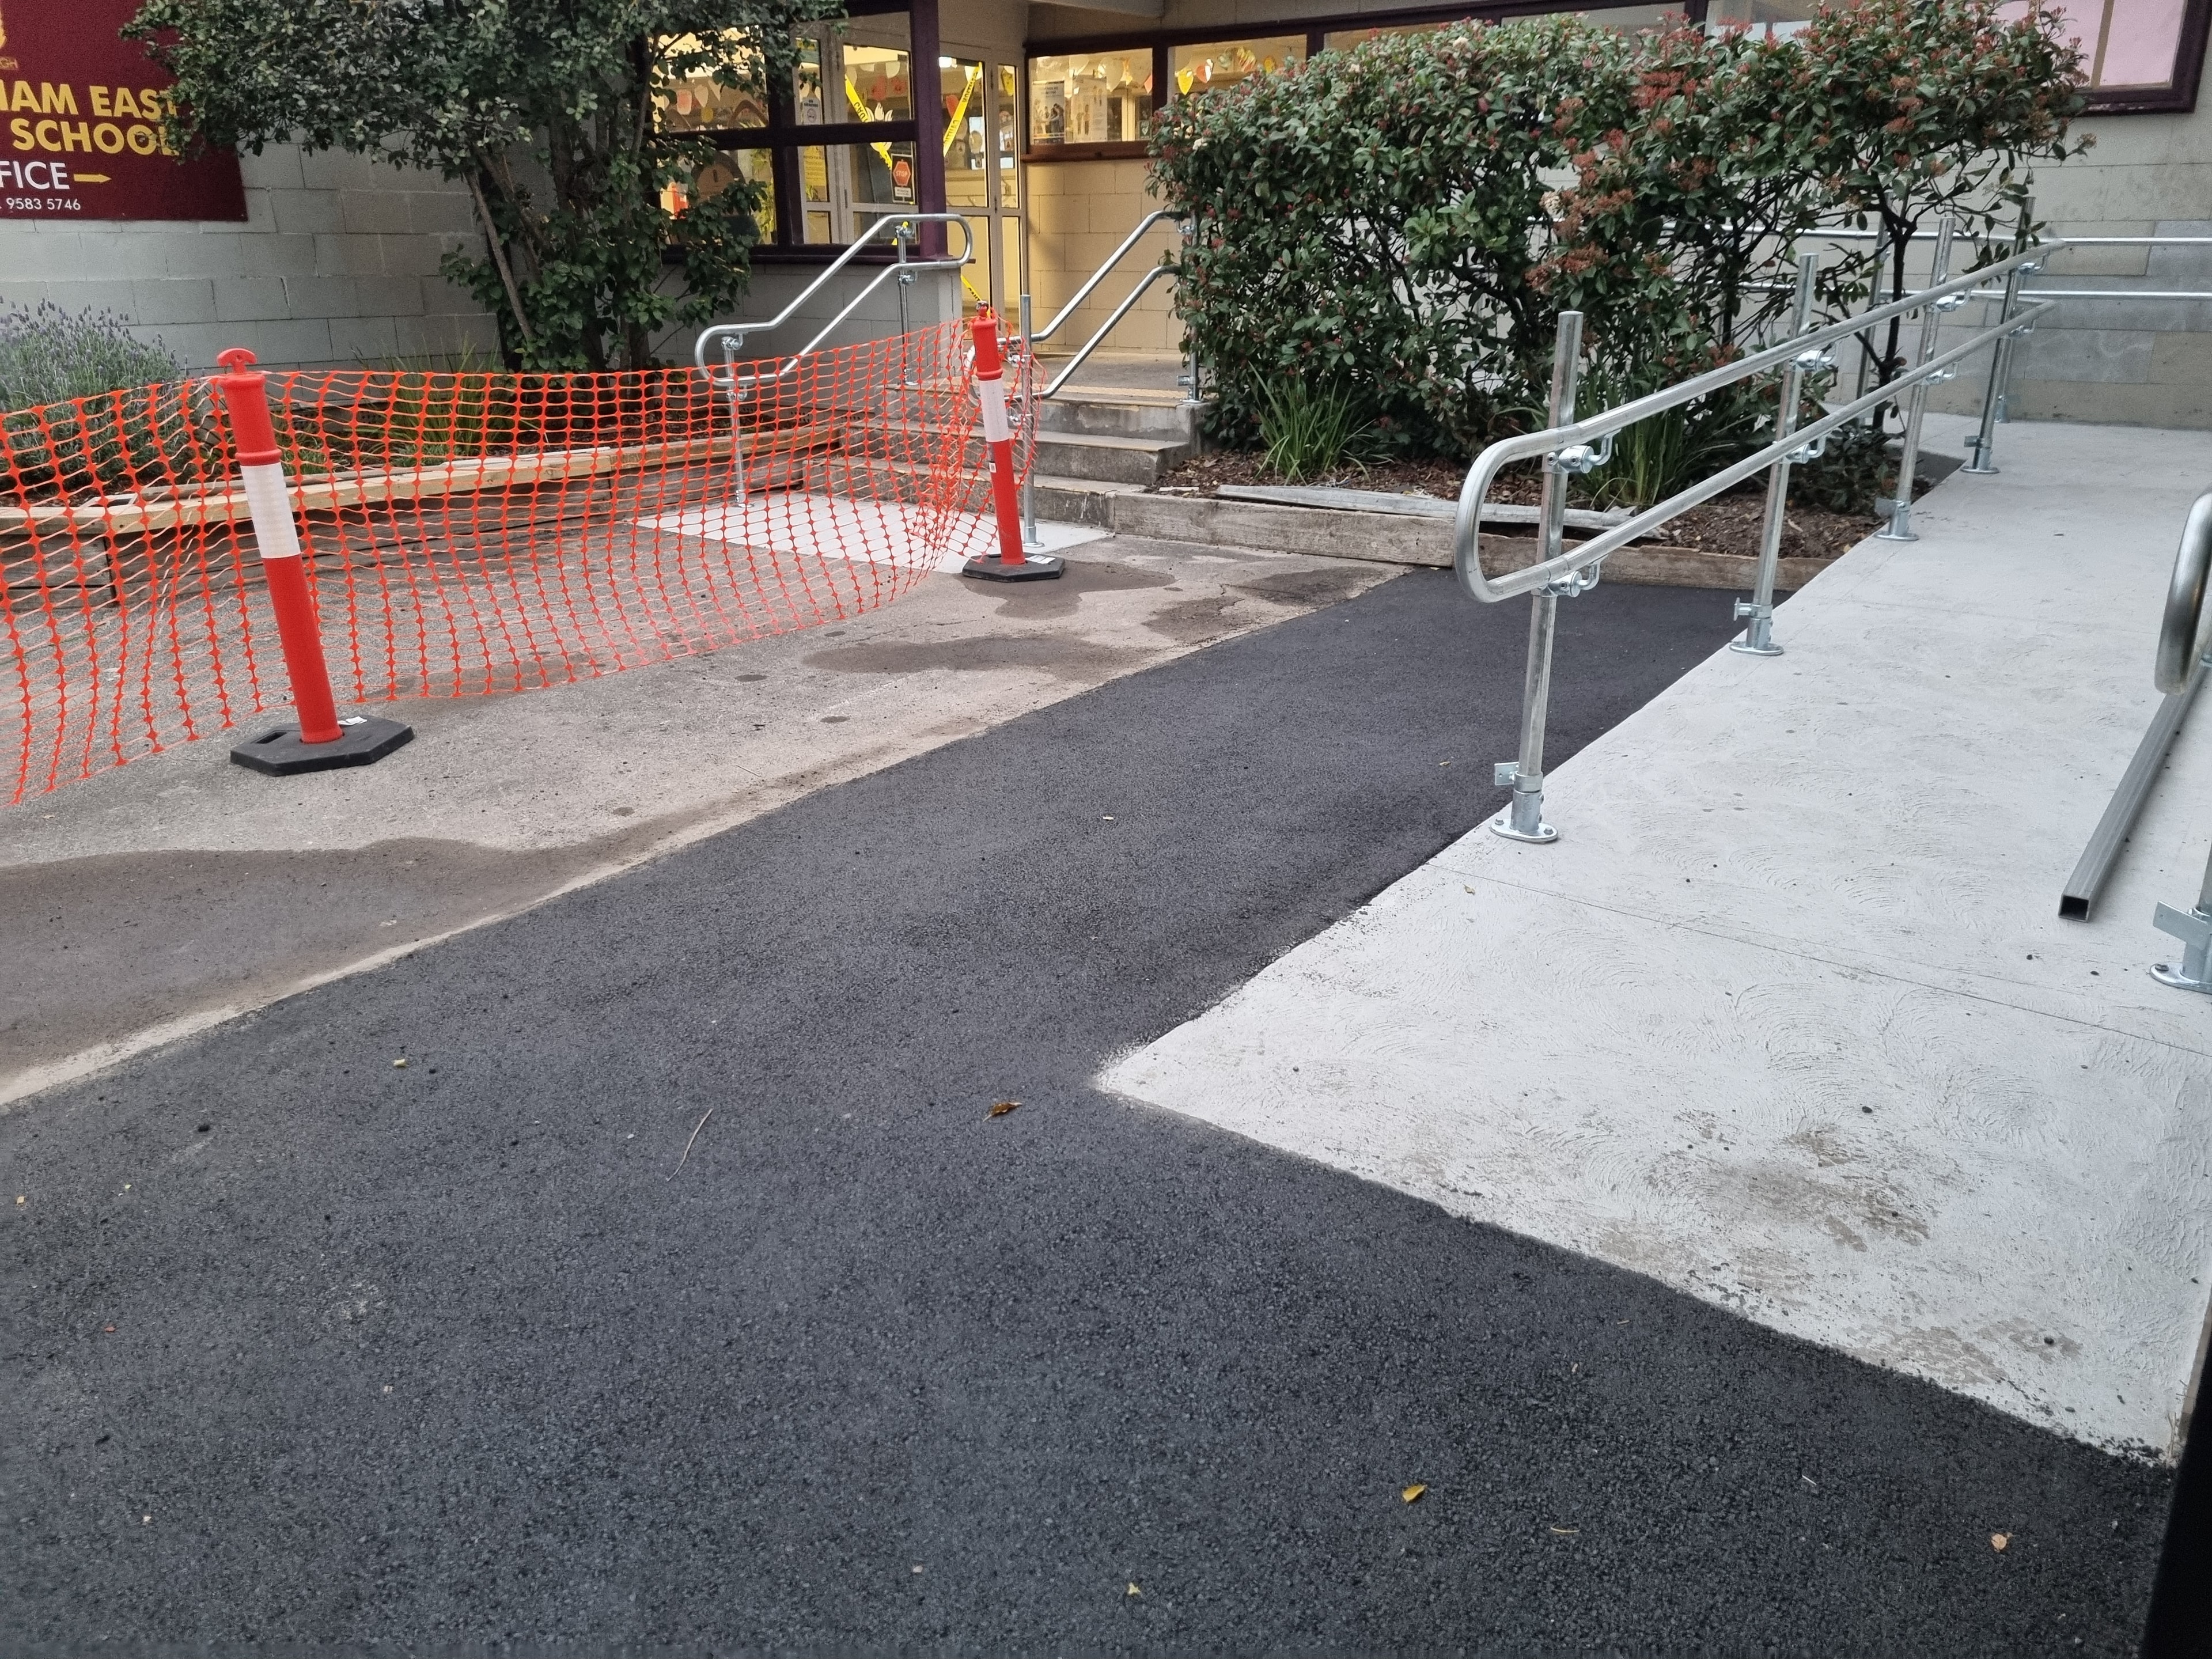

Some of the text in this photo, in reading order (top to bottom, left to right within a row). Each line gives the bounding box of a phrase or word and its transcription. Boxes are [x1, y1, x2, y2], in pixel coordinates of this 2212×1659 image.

[0, 79, 178, 122] AM EAST
[10, 118, 180, 156] SCHOOL
[6, 198, 81, 210] 9583 5746
